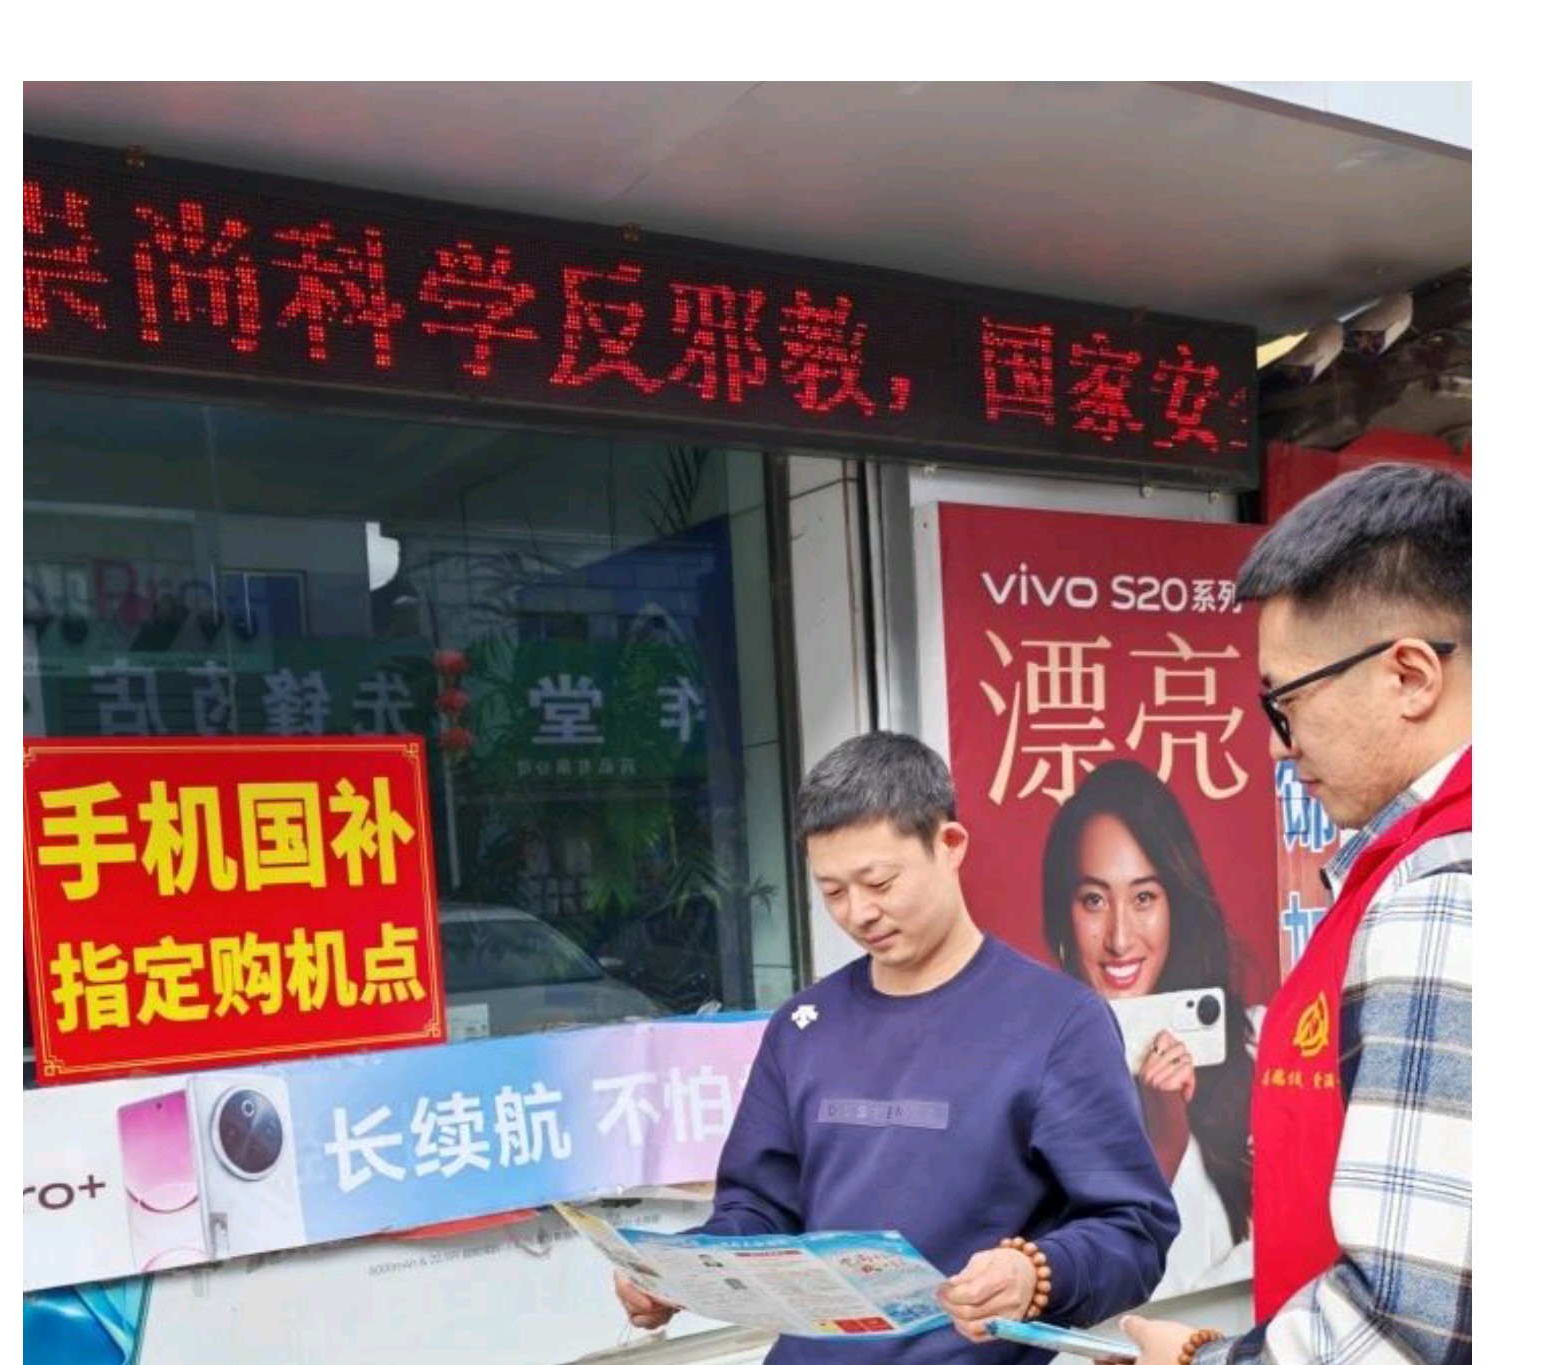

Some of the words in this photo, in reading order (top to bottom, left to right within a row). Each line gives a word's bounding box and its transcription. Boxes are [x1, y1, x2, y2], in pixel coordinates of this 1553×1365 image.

[981, 562, 1098, 608] vivo
[1111, 574, 1243, 614] S20系列
[980, 630, 1248, 806] 漂亮
[38, 777, 414, 900] 手机国补
[50, 922, 426, 1034] 指定购机点
[324, 1081, 572, 1194] 长续航
[592, 1064, 750, 1147] 不怕
